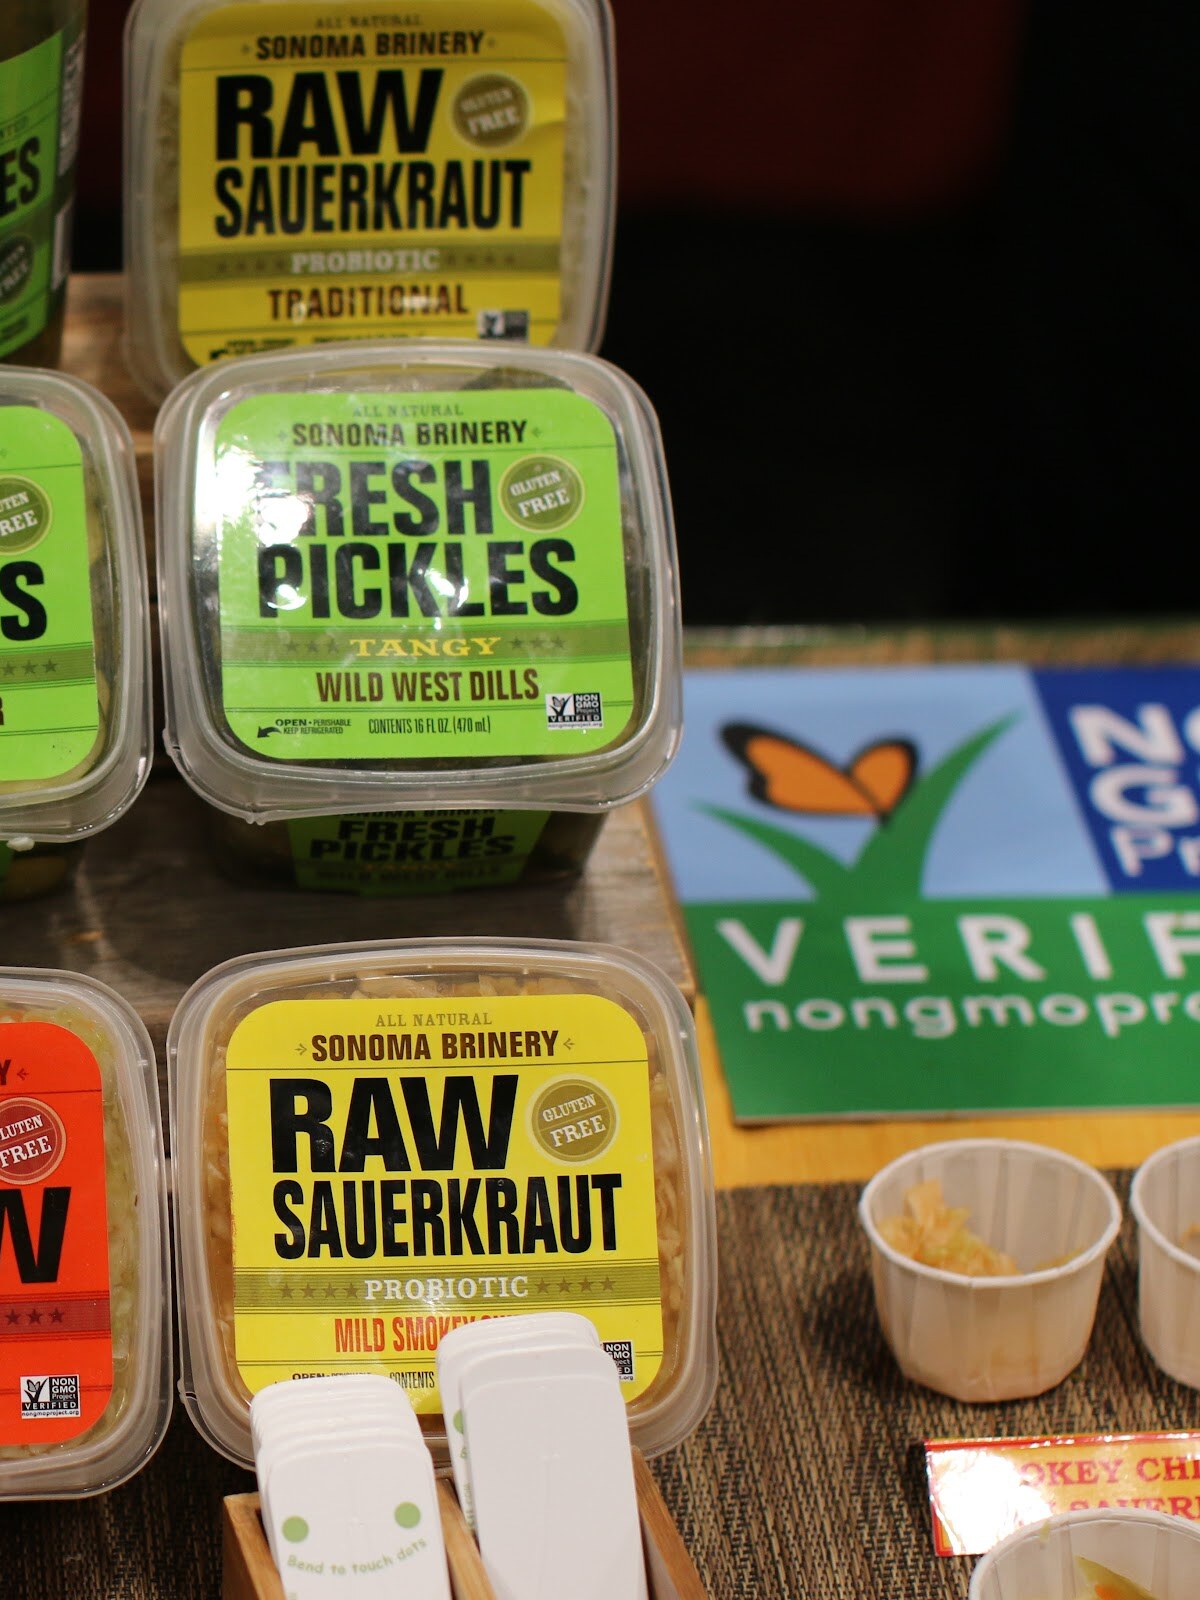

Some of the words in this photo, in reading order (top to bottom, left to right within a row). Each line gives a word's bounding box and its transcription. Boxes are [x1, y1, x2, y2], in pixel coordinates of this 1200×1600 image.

[256, 36, 366, 60] SONOMA
[376, 31, 484, 56] BRINERY
[216, 68, 444, 161] RAW
[467, 110, 520, 136] FREE
[215, 160, 531, 238] SAUERKRAUT
[291, 249, 441, 274] PROBIOTIC
[267, 284, 469, 320] TRADITIONAL
[292, 423, 404, 446] SONOMA
[416, 420, 526, 445] BRINERY
[510, 471, 560, 496] GLUTEN
[518, 489, 570, 518] FREE
[258, 538, 580, 619] PICKLES
[349, 636, 501, 657] TANGY
[316, 672, 383, 702] WILD
[393, 672, 462, 701] WEST
[469, 669, 540, 700] DILLS
[338, 817, 495, 841] FRESH
[310, 835, 516, 861] PICKLES
[717, 911, 1200, 986] VERIF
[376, 1014, 407, 1027] ALL
[413, 1012, 492, 1026] NATURAL
[311, 1034, 430, 1061] SONOMA
[442, 1030, 559, 1059] BRINERY
[542, 1094, 597, 1123] GLUTEN
[269, 1074, 519, 1174] RAW
[550, 1115, 606, 1148] FREE
[273, 1173, 622, 1260] SAUERKRAUT
[364, 1276, 529, 1300] PROBIOTIC
[335, 1318, 385, 1352] MILD
[393, 1315, 475, 1351] SMOK
[1020, 1460, 1123, 1487] OKEY
[287, 1555, 324, 1574] Bend
[331, 1565, 346, 1575] to
[353, 1554, 393, 1574] touch
[397, 1538, 427, 1561] dots
